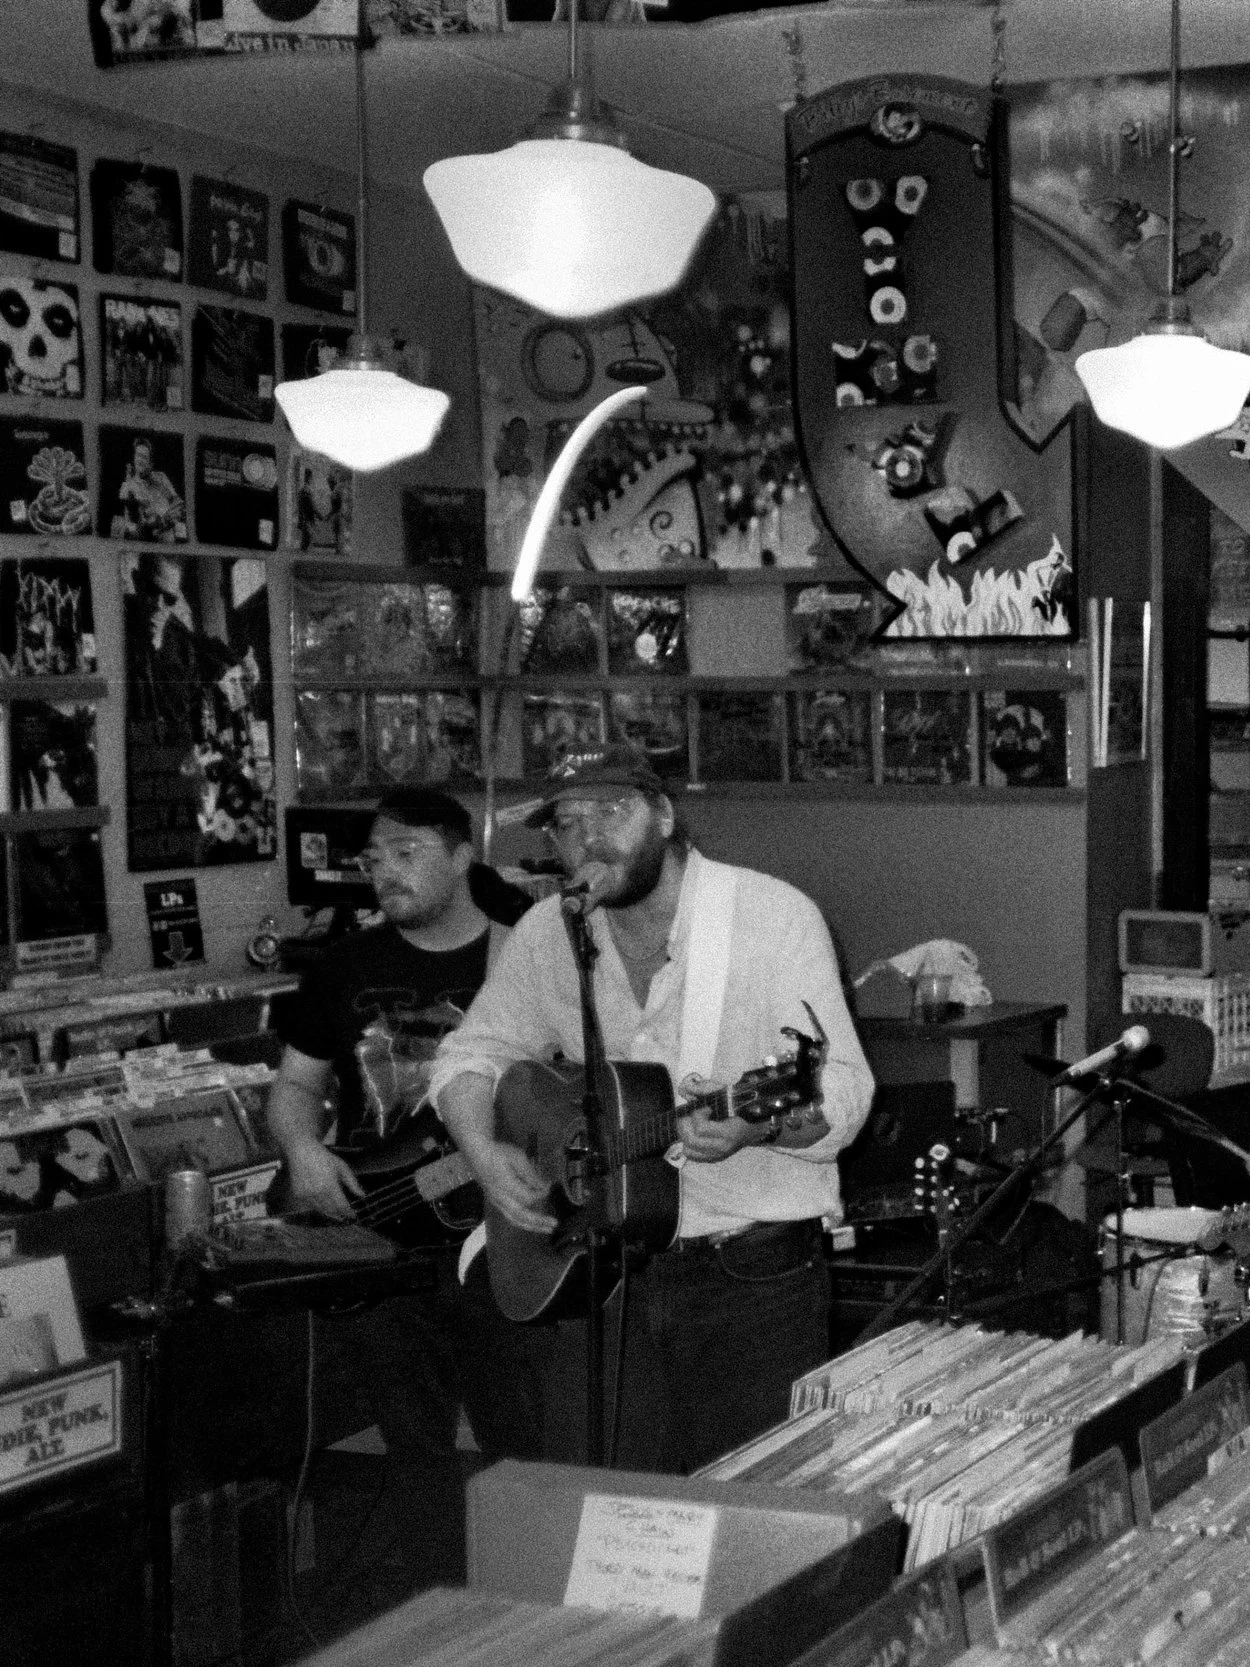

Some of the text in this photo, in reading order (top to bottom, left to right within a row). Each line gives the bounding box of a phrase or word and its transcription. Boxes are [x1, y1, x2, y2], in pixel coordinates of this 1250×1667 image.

[218, 1180, 247, 1198] NEW
[22, 1393, 68, 1422] NEW
[1, 1403, 109, 1451] DIE, PUNK,
